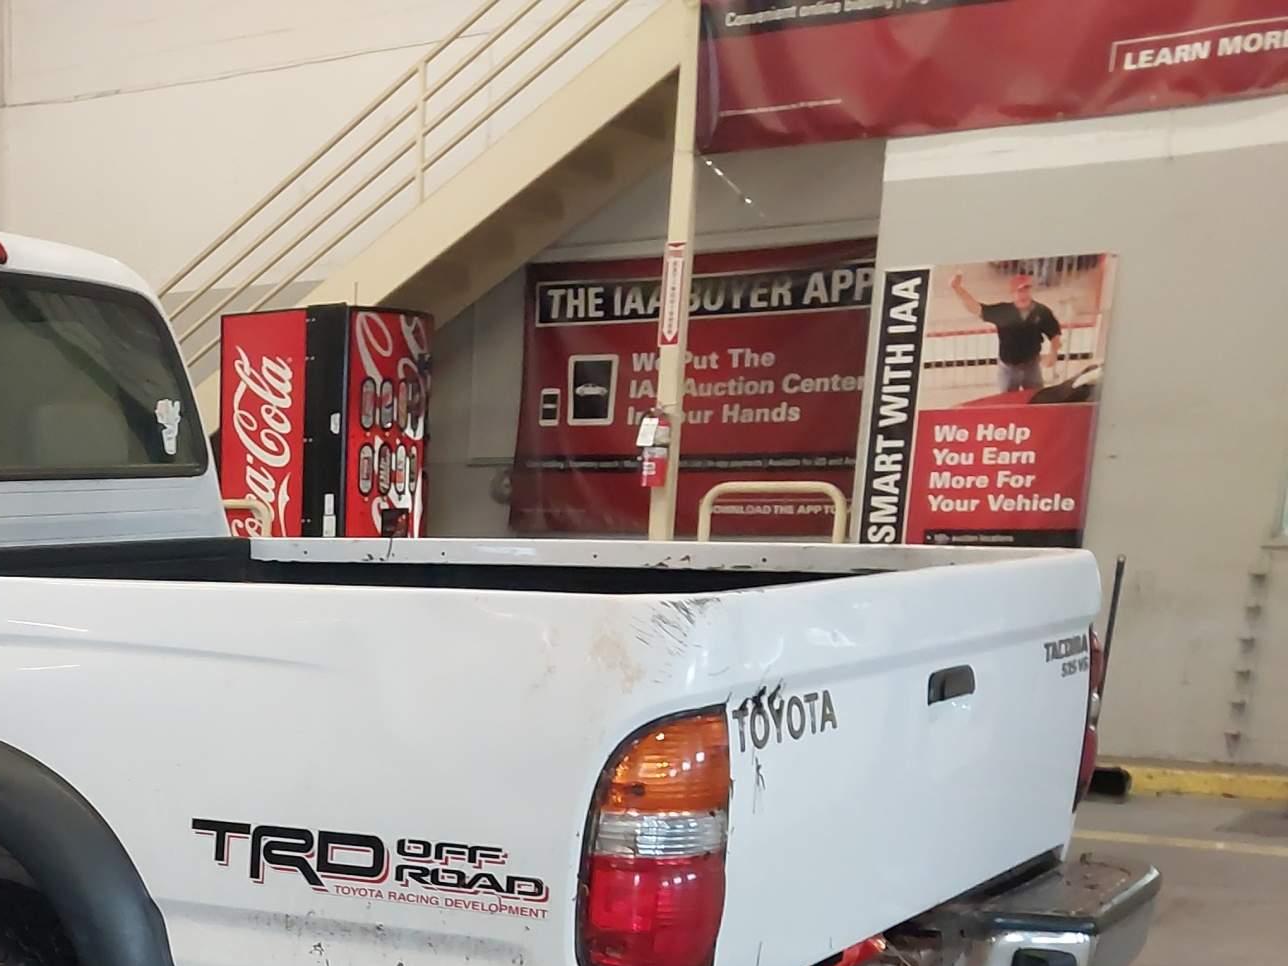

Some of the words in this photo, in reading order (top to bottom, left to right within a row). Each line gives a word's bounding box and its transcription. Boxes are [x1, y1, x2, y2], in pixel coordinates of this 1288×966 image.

[1123, 40, 1211, 70] LEARN
[547, 286, 605, 319] THE
[802, 267, 875, 305] APP
[887, 276, 922, 333] IAA
[728, 348, 775, 369] The
[629, 379, 658, 399] IA
[683, 376, 774, 397] Auction
[782, 373, 864, 394] Center
[879, 343, 915, 427] WITH
[722, 402, 801, 423] Hands
[934, 425, 969, 442] We
[976, 423, 1031, 444] Help
[932, 448, 974, 466] You
[982, 447, 1036, 465] Earn
[867, 436, 906, 544] SMART
[929, 471, 989, 489] More
[996, 470, 1036, 488] For
[712, 504, 771, 515] OWNLOAD
[797, 504, 822, 515] APP
[928, 494, 980, 512] Your
[987, 493, 1075, 512] Vehicle
[732, 687, 838, 753] TOYOTA
[192, 818, 390, 893] TRD
[396, 838, 508, 868] OFF
[395, 865, 550, 903] ROAD
[334, 885, 384, 900] TOYOTA
[388, 891, 440, 907] RACING
[444, 897, 548, 919] DEVELOPMENT
